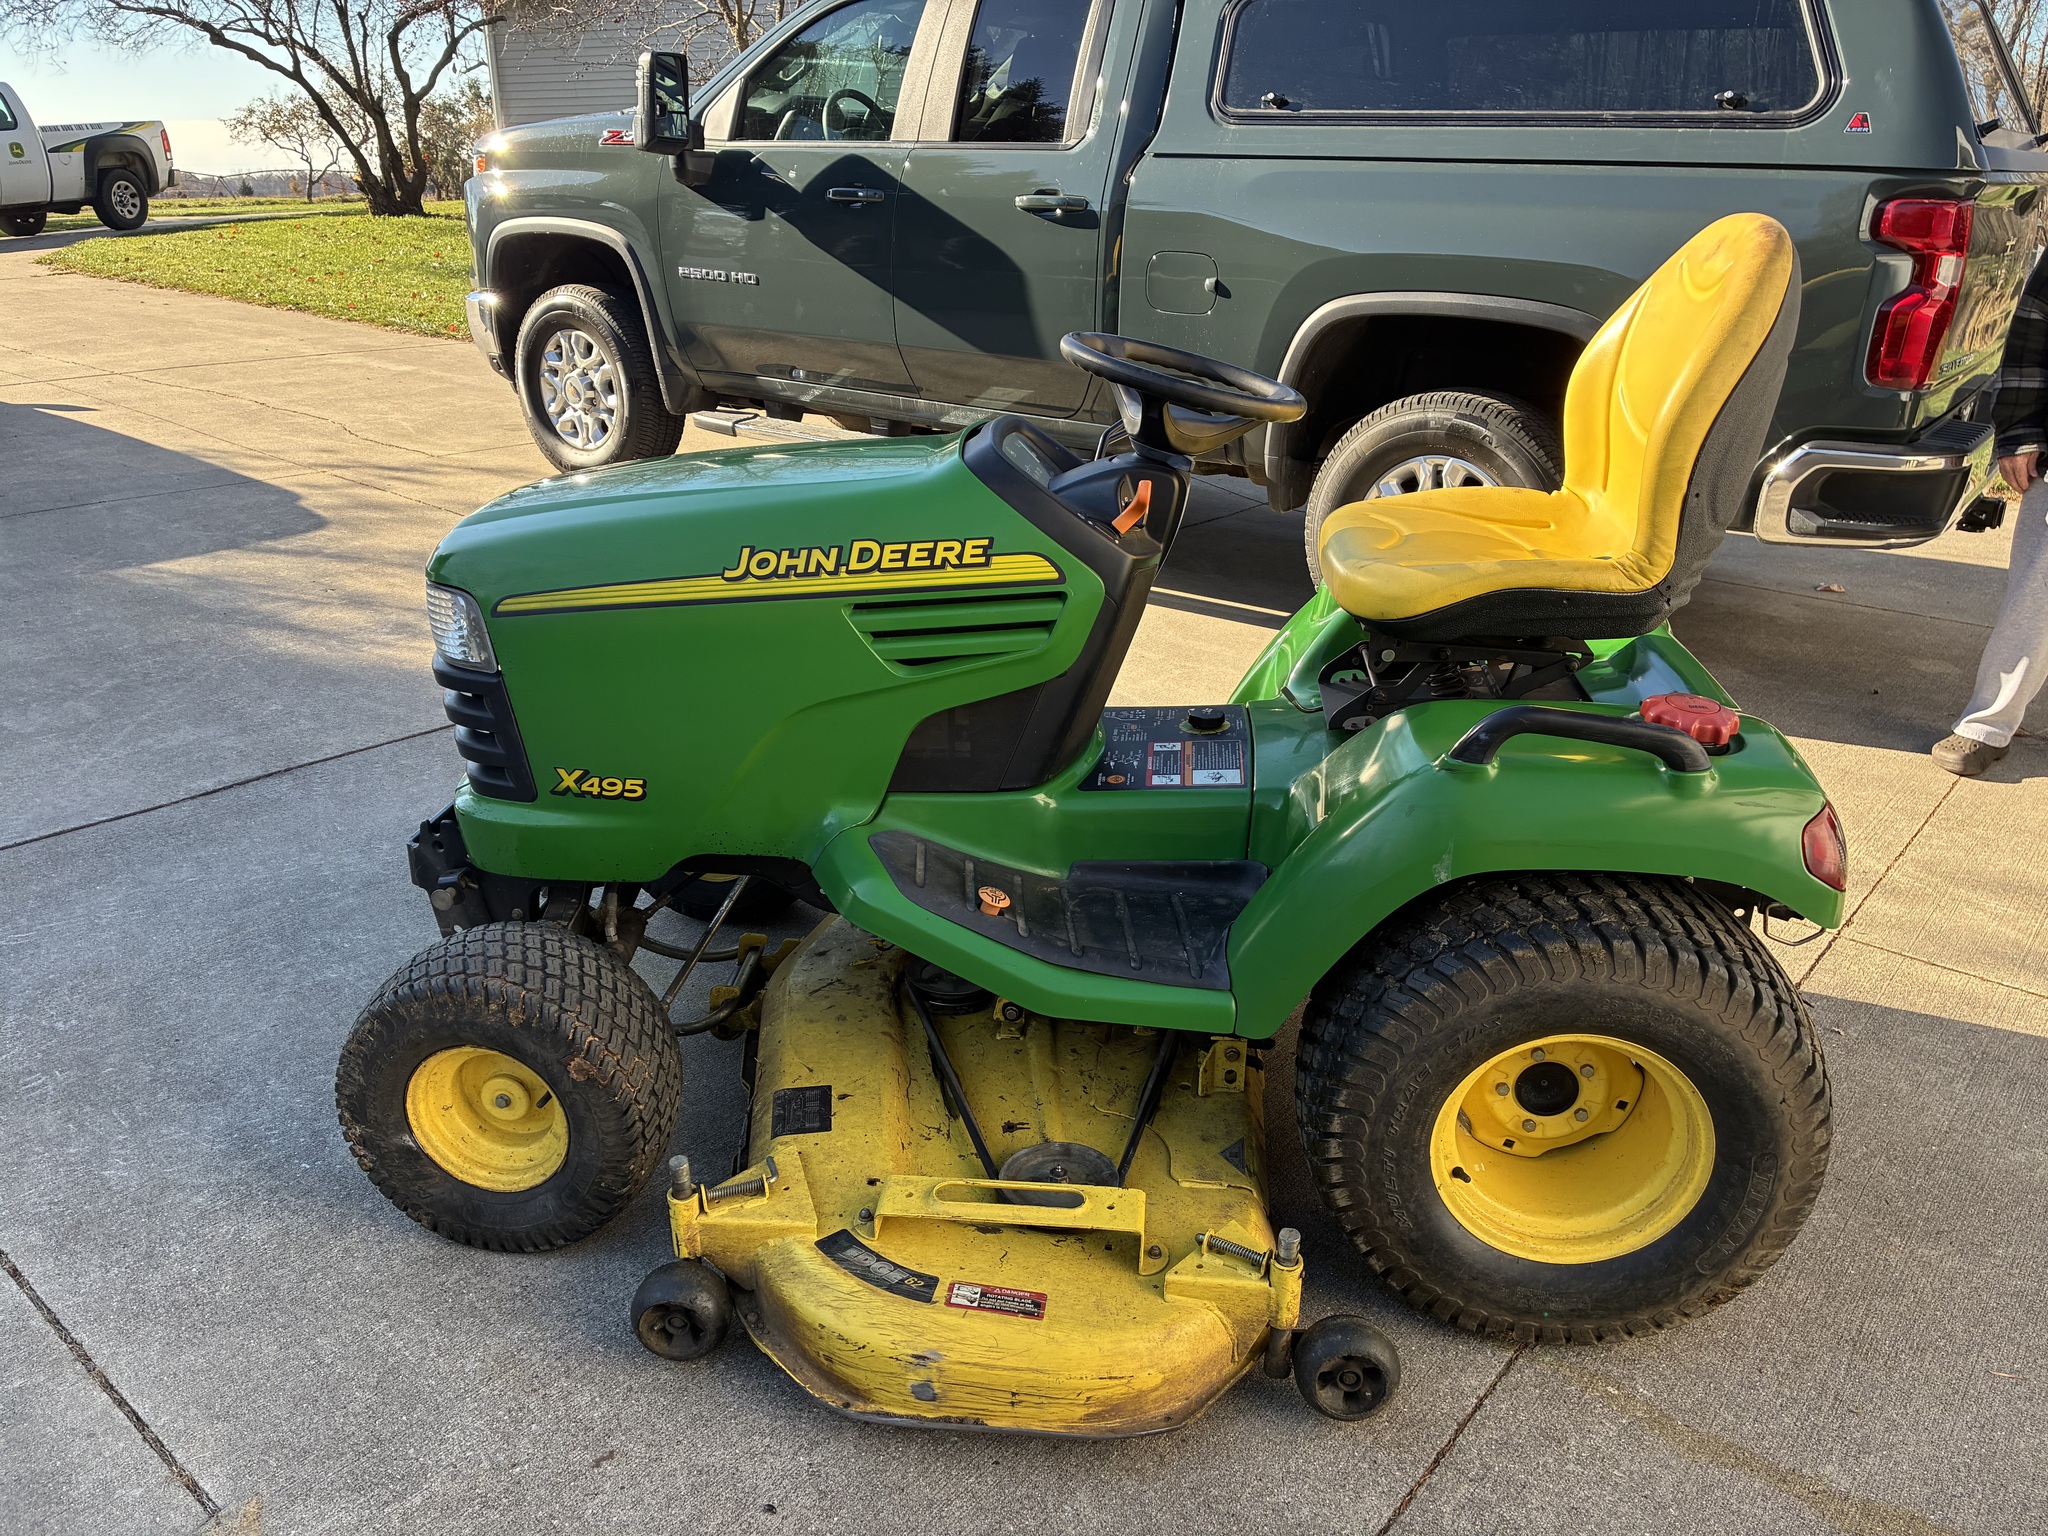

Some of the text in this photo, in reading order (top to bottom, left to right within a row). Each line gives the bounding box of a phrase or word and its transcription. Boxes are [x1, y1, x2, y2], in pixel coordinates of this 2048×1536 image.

[678, 266, 758, 286] 2500 HD
[721, 537, 994, 581] JOHN DEERE
[550, 766, 648, 801] X495
[1388, 1062, 1432, 1137] TRAC
[1383, 1147, 1413, 1229] MULTI
[1716, 1171, 1775, 1256] TITAN
[904, 1277, 925, 1289] 62
[986, 1293, 1014, 1301] ROTATING
[1002, 1289, 1030, 1298] DANGER
